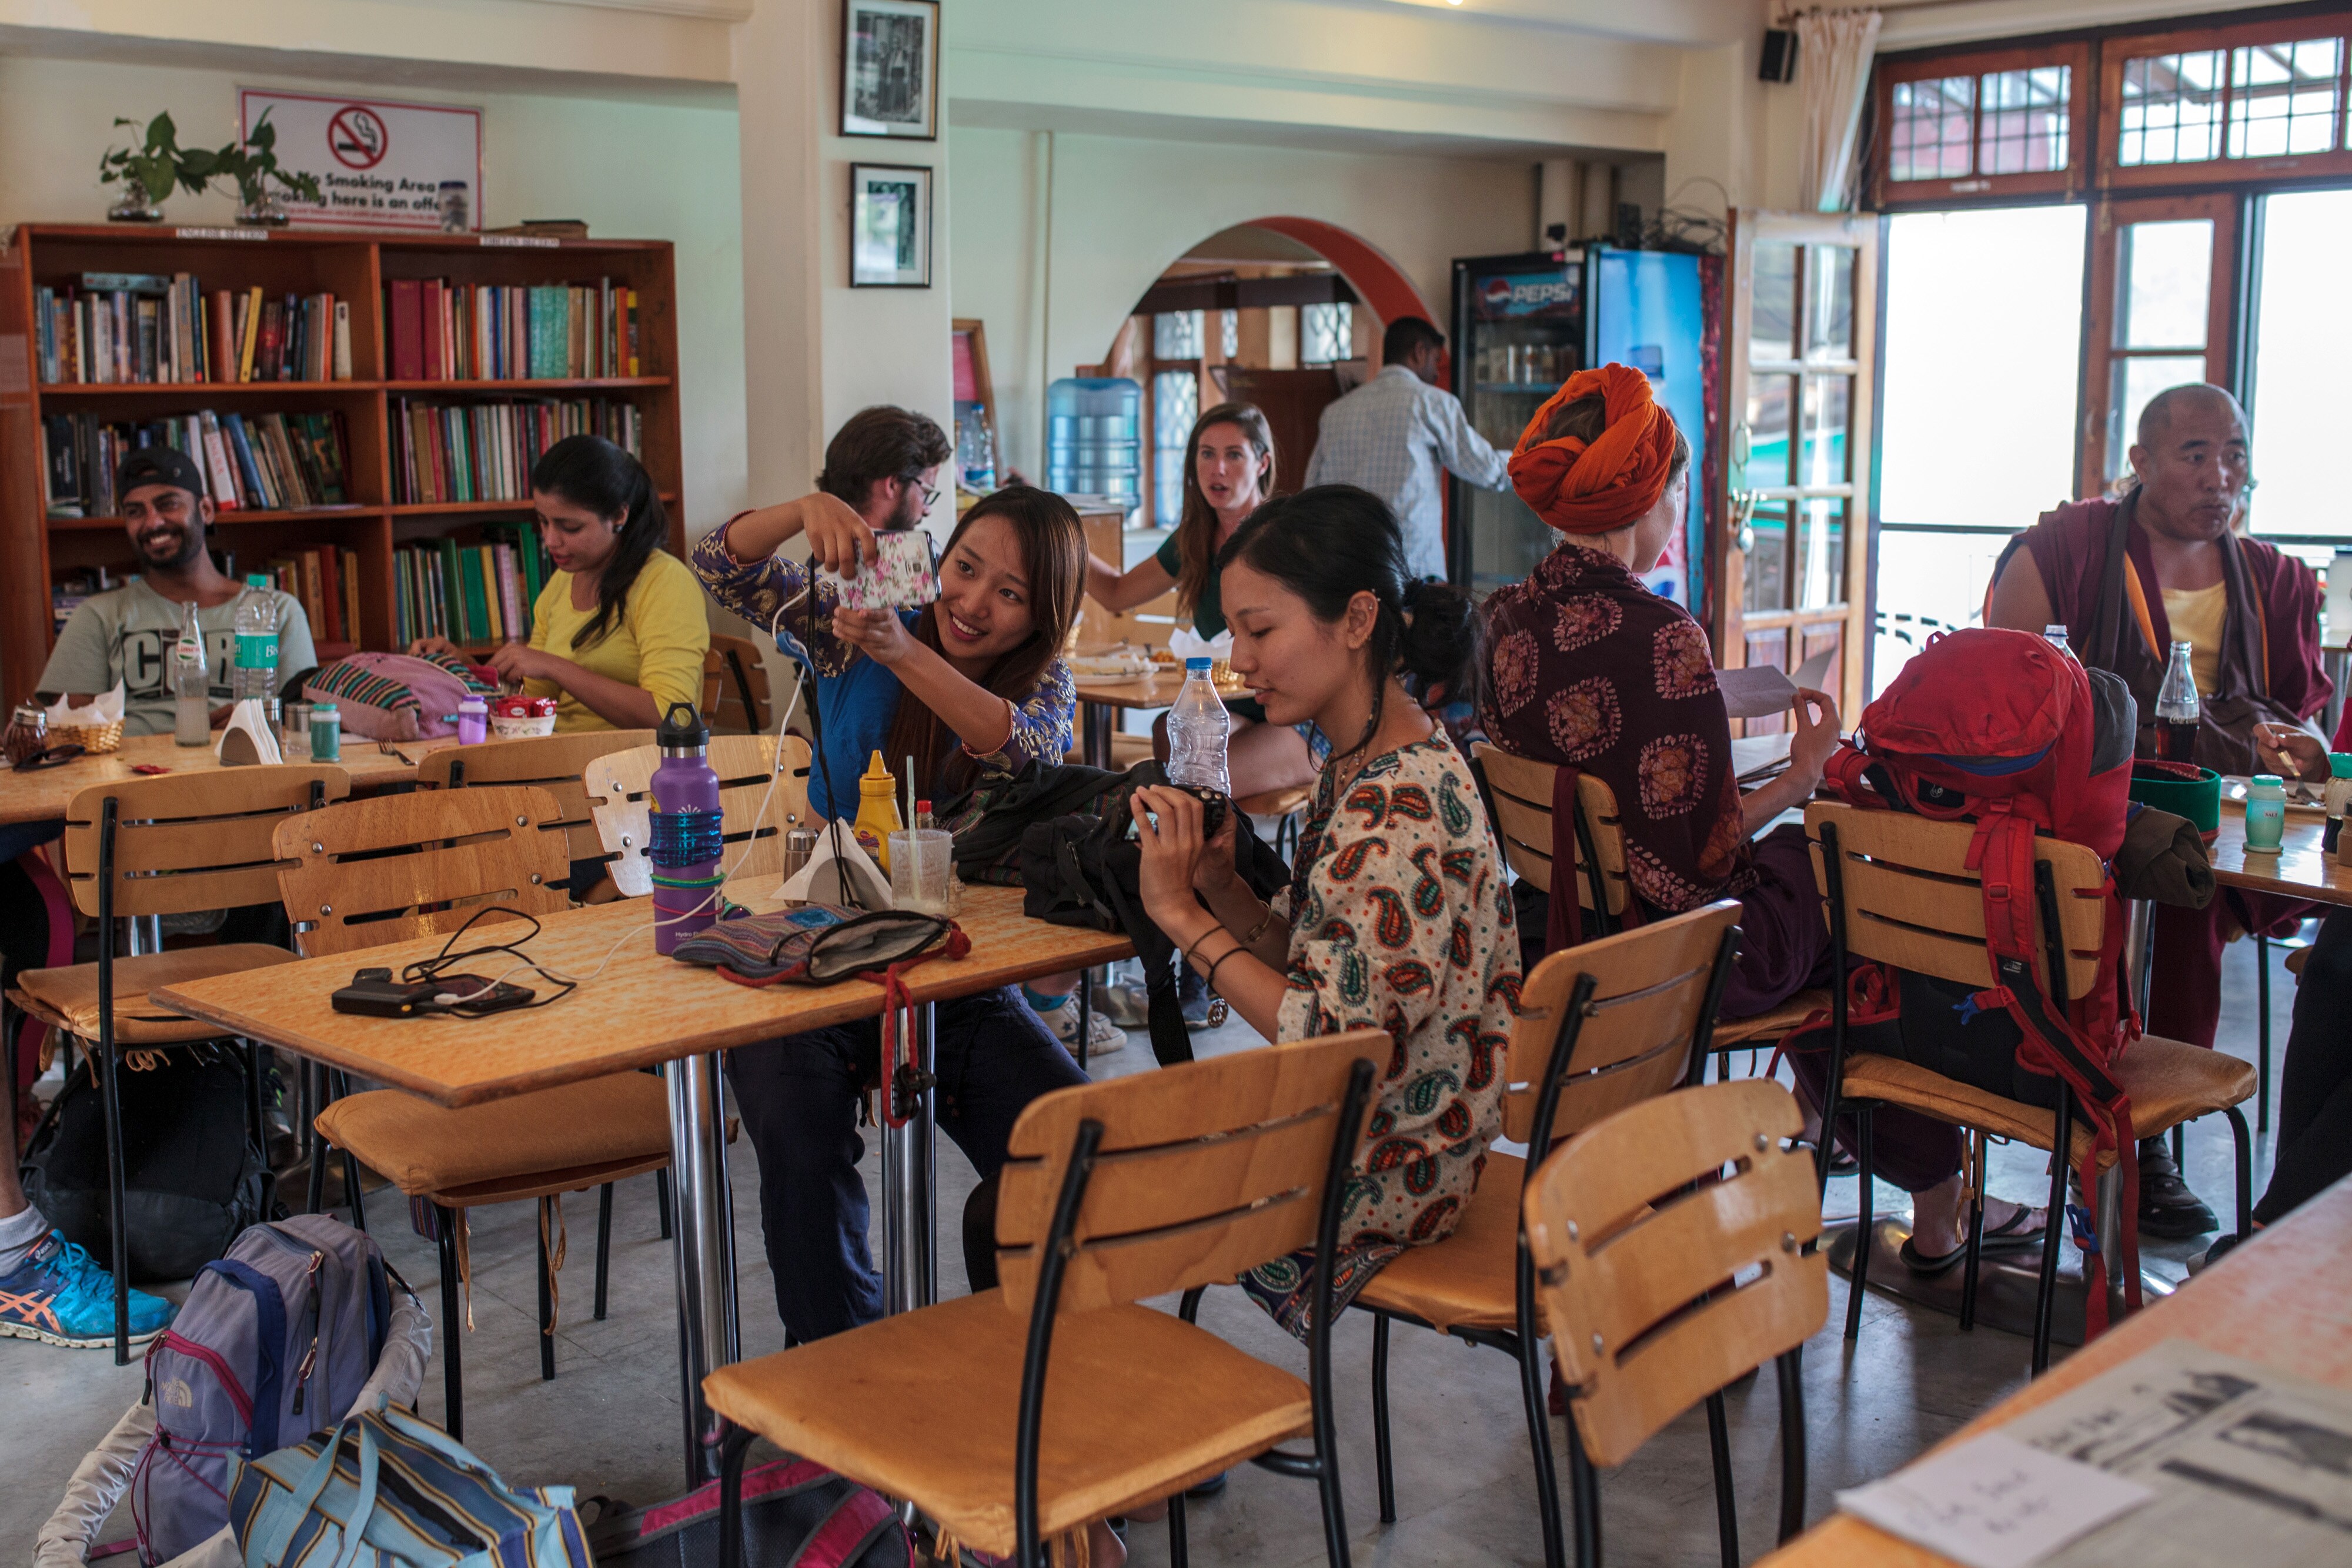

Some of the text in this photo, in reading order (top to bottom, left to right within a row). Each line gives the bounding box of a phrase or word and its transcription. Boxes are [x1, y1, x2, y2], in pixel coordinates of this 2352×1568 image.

[325, 172, 394, 193] Smoking
[399, 178, 436, 193] Area
[332, 190, 367, 206] here
[372, 193, 384, 208] is
[389, 197, 408, 209] an
